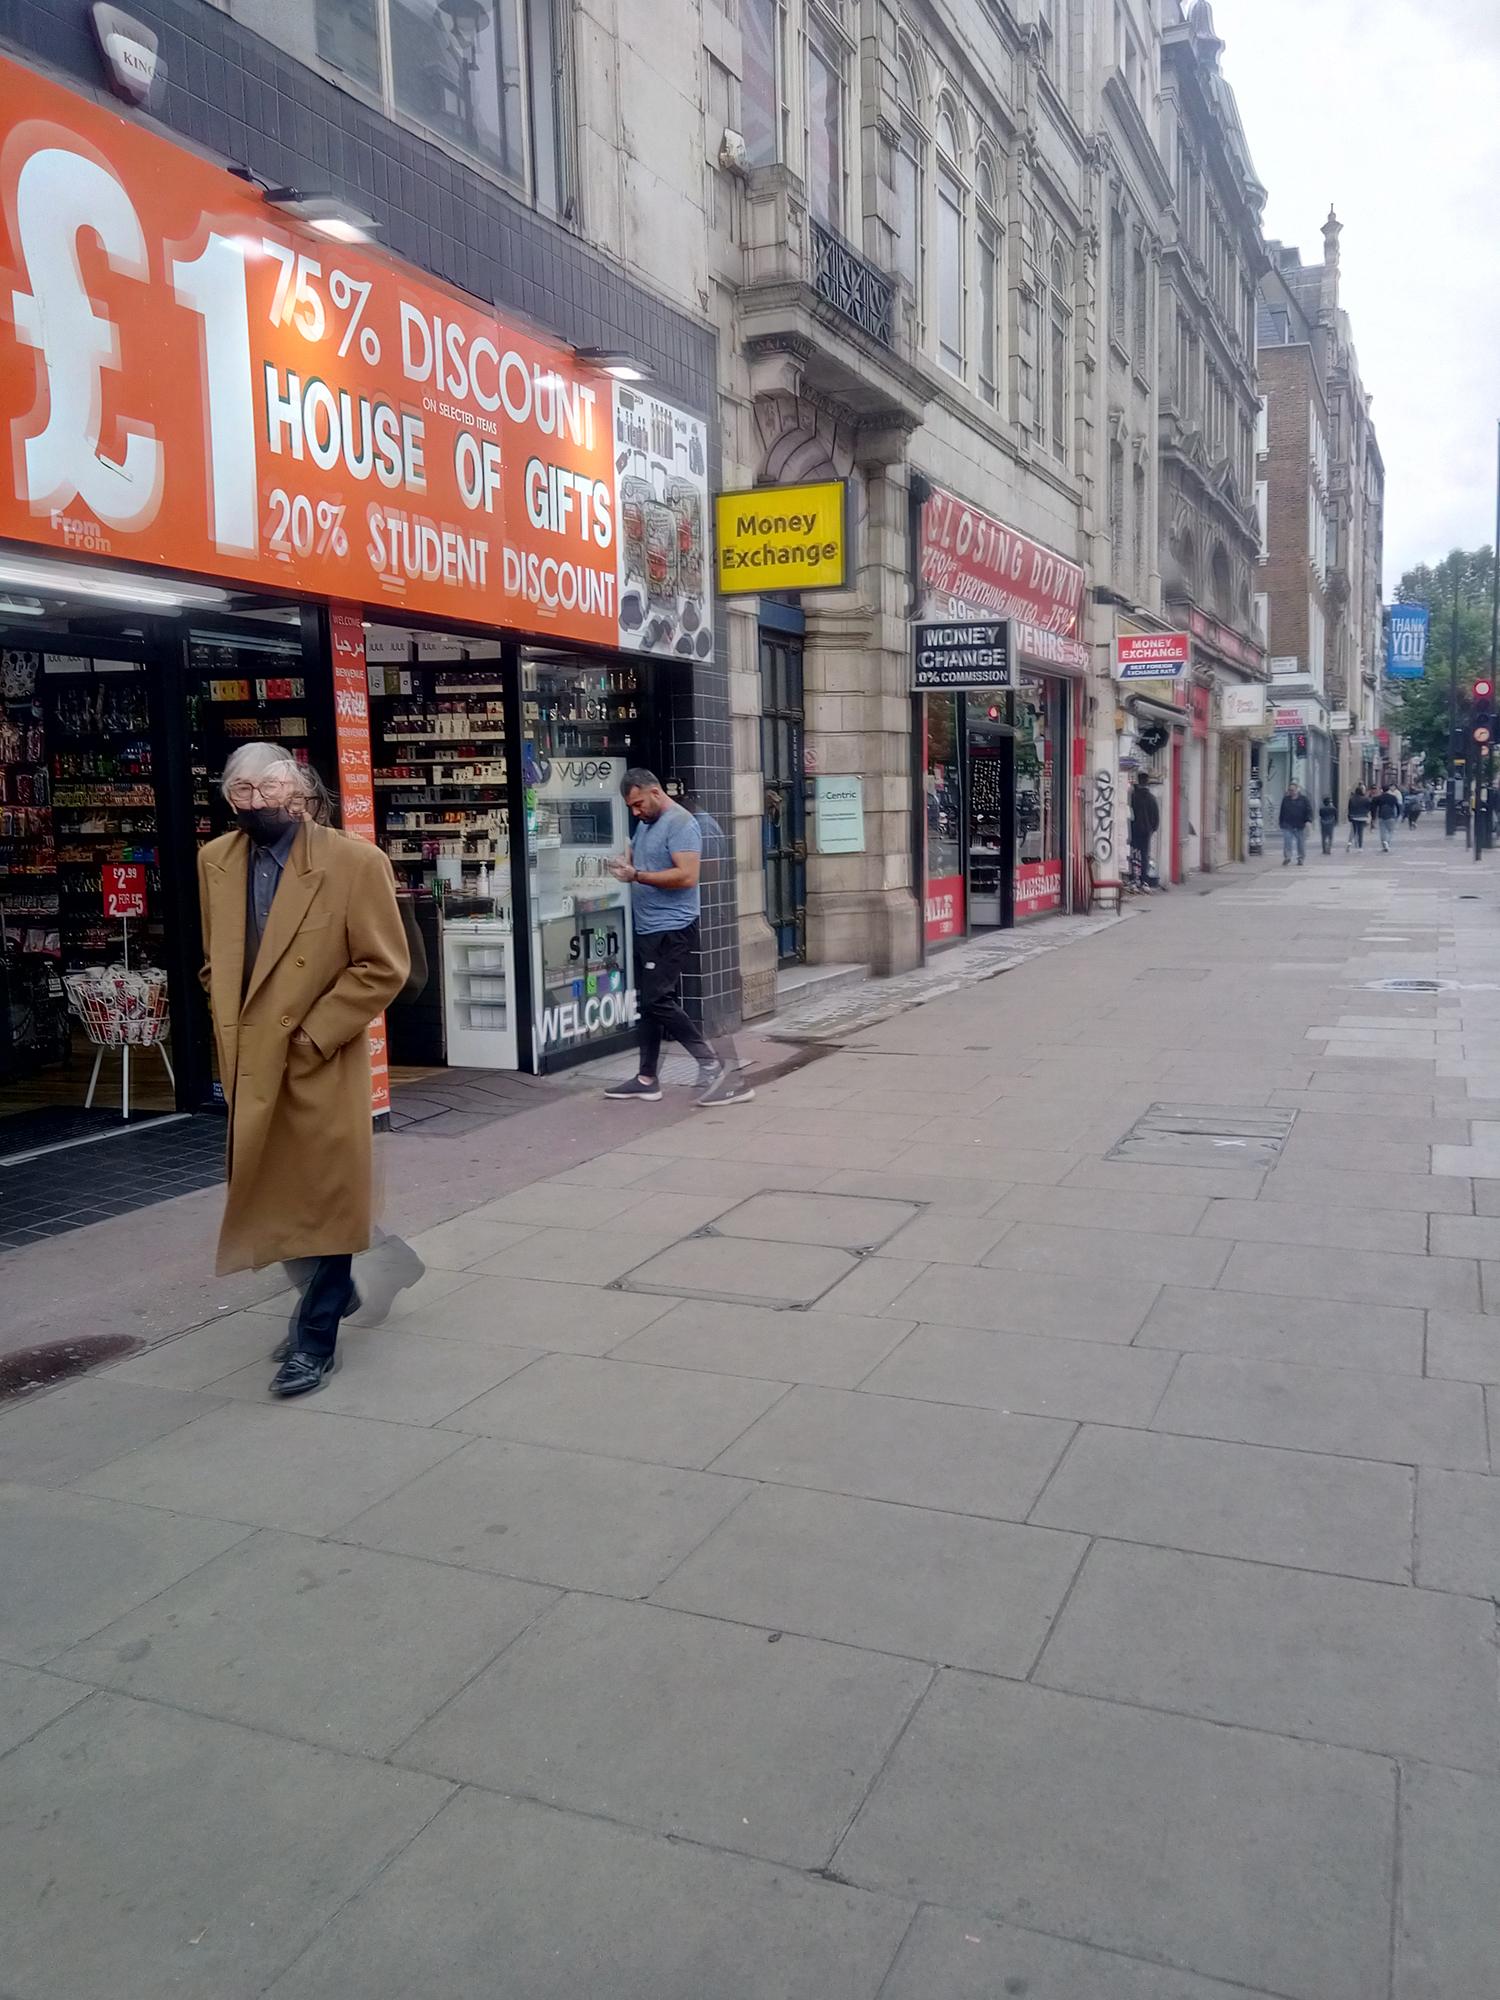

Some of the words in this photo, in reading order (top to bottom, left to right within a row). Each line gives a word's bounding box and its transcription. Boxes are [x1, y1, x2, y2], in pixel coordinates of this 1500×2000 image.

[11, 143, 258, 557] £1
[262, 237, 381, 366] 75%
[400, 300, 595, 451] DISCOUNT
[423, 397, 437, 411] ON
[439, 404, 475, 425] SELECTED
[476, 416, 497, 435] ITEMS
[264, 360, 427, 494] HOUSE
[455, 430, 501, 514] OF
[525, 456, 612, 548] GIFTS
[736, 513, 817, 538] Money
[264, 488, 350, 558] 20%
[366, 510, 489, 591] STUDENT
[503, 546, 615, 618] DISCOUNT
[722, 543, 836, 569] Exchange
[928, 494, 1023, 581] CLOSING
[1029, 550, 1079, 606] DOWN
[952, 572, 1007, 612] EVERYTHING
[332, 614, 361, 628] WELCOME
[1392, 618, 1426, 632] THANK
[923, 627, 999, 646] MONEY
[1132, 638, 1172, 649] MONEY
[1392, 632, 1426, 659] YOU
[918, 648, 1006, 668] CHANGE
[1073, 643, 1089, 671] 99p
[1122, 647, 1183, 659] EXCHANGE
[941, 671, 1007, 682] COMMISSION
[557, 760, 612, 787] vype
[826, 790, 857, 800] Centric
[113, 867, 137, 889] £2.99
[108, 893, 117, 915] 2
[118, 893, 130, 905] FOR
[131, 893, 143, 914] £5
[924, 894, 954, 922] ALE
[537, 989, 642, 1045] WELCOME
